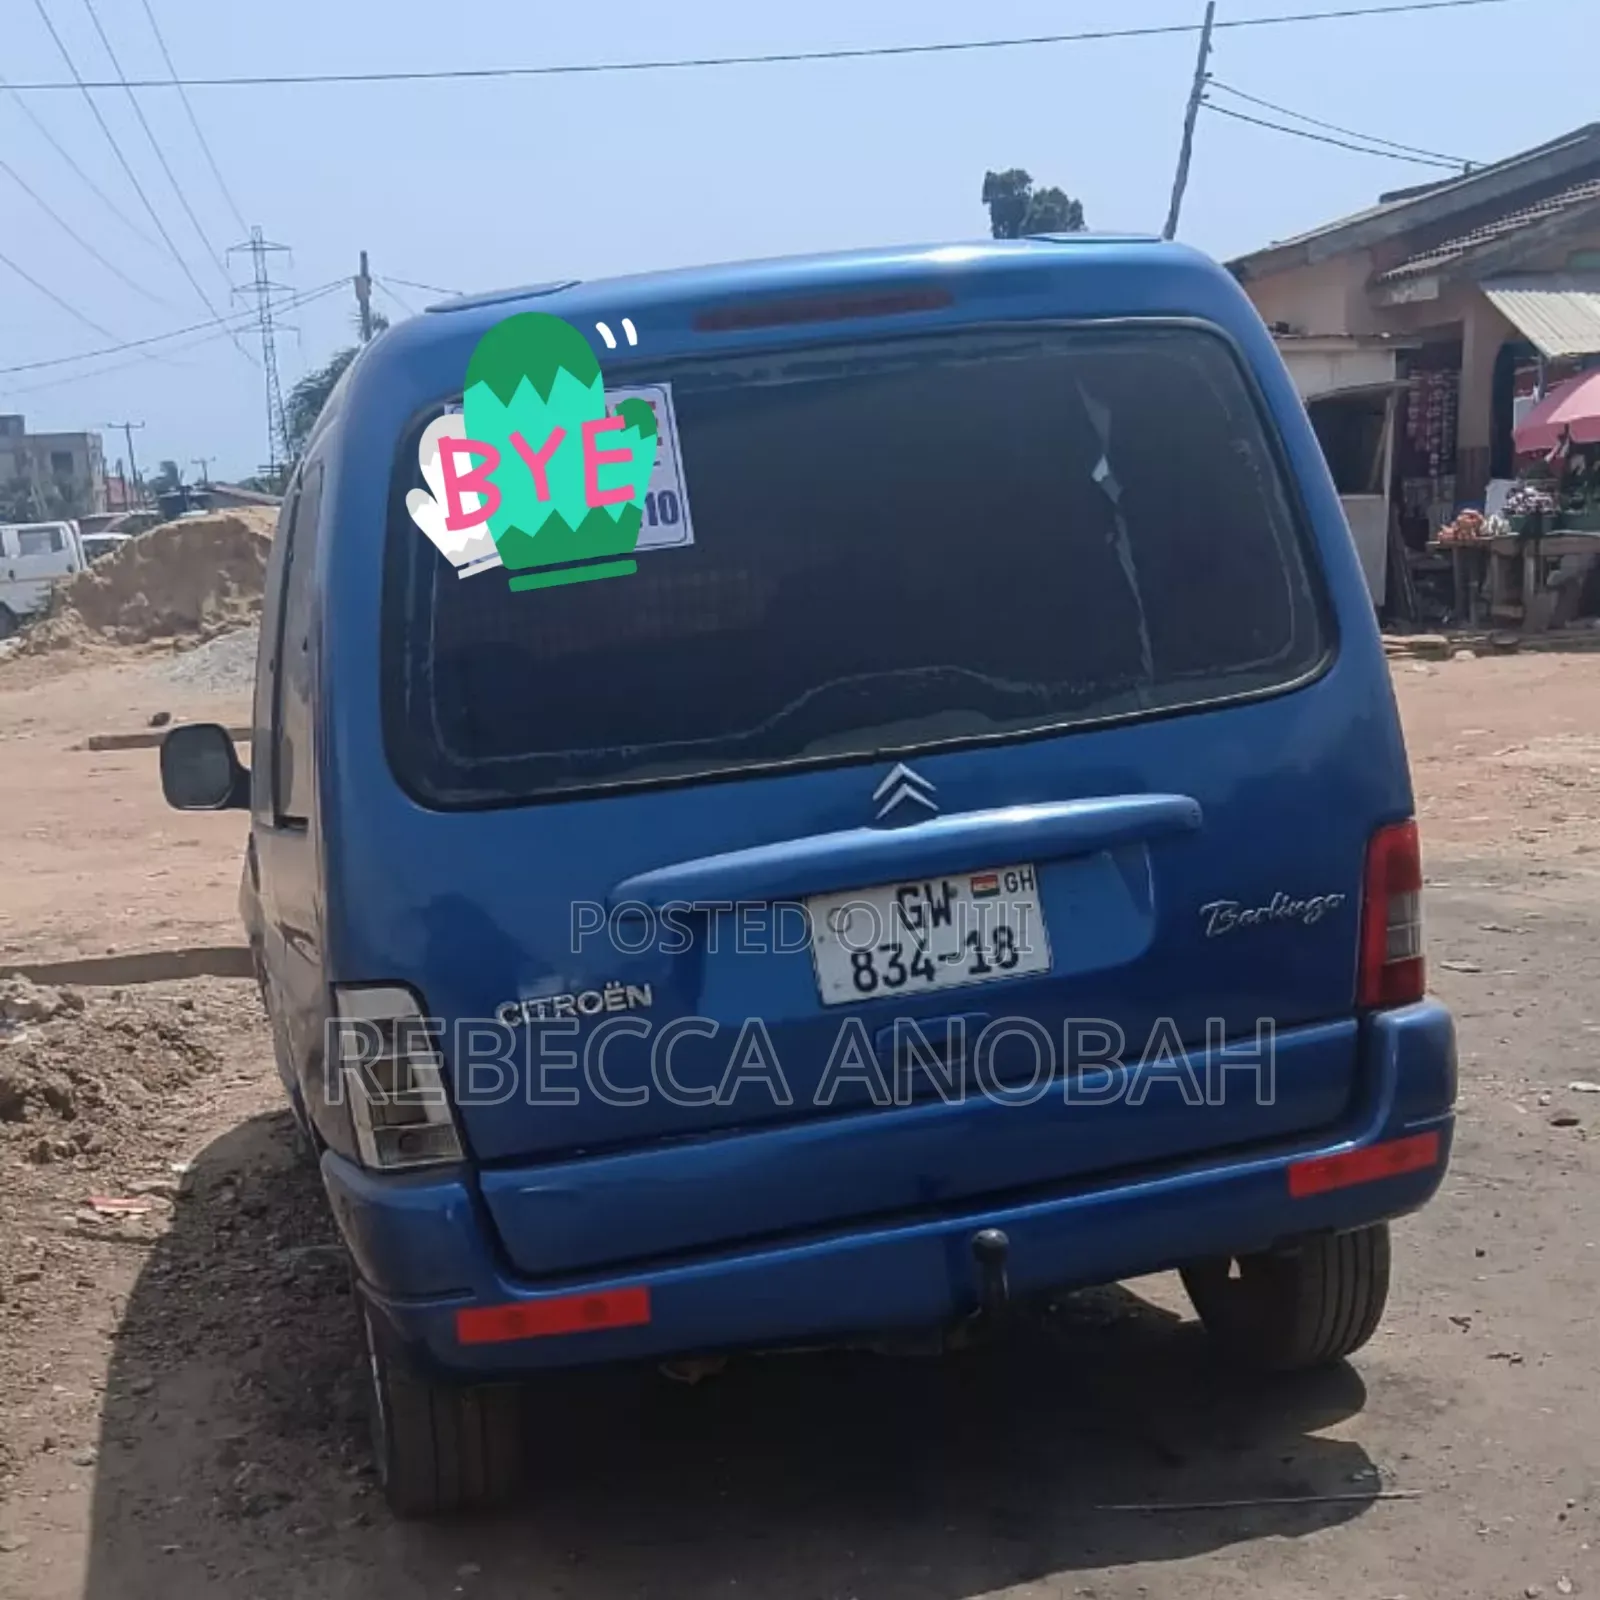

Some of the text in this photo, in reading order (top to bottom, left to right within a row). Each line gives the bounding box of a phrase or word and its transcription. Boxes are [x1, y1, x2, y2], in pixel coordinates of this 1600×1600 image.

[640, 489, 680, 528] 10
[896, 870, 1034, 931] GW GH
[1200, 892, 1346, 938] Berlingo
[851, 925, 1019, 992] 834-18
[494, 981, 653, 1028] CITROËN
